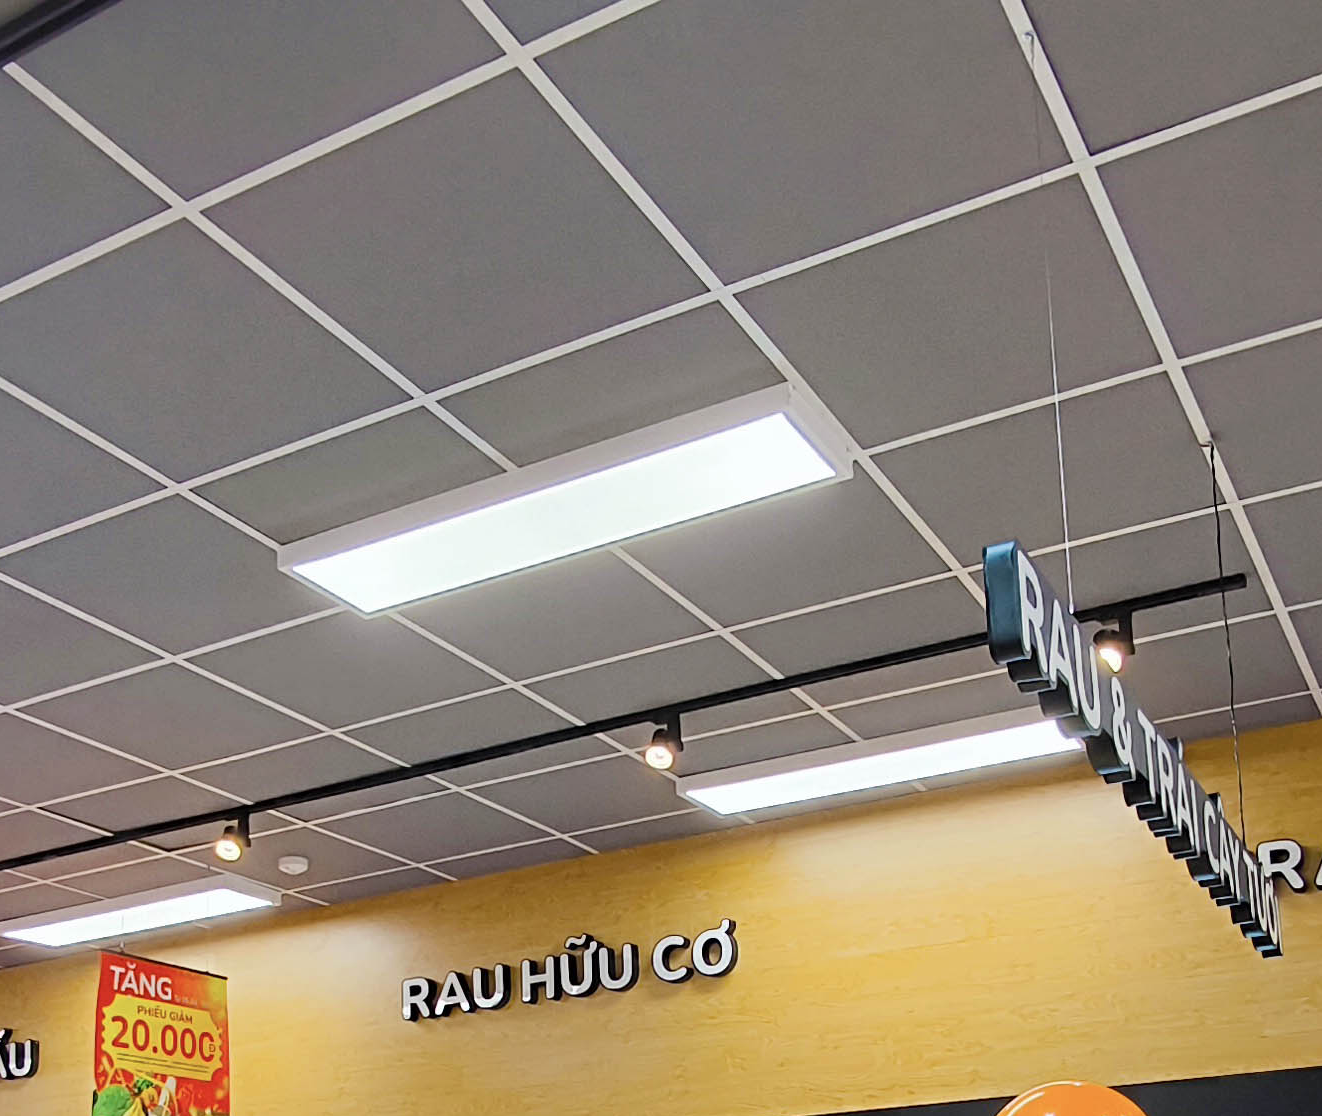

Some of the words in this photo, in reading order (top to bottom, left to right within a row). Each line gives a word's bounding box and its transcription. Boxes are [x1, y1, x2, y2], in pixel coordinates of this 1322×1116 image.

[1017, 550, 1101, 730] RAU
[1111, 676, 1135, 781] &
[1137, 709, 1200, 856] TRÁI
[402, 962, 509, 1021] RAU
[521, 934, 637, 1004] HỮU
[652, 918, 738, 983] CƠ
